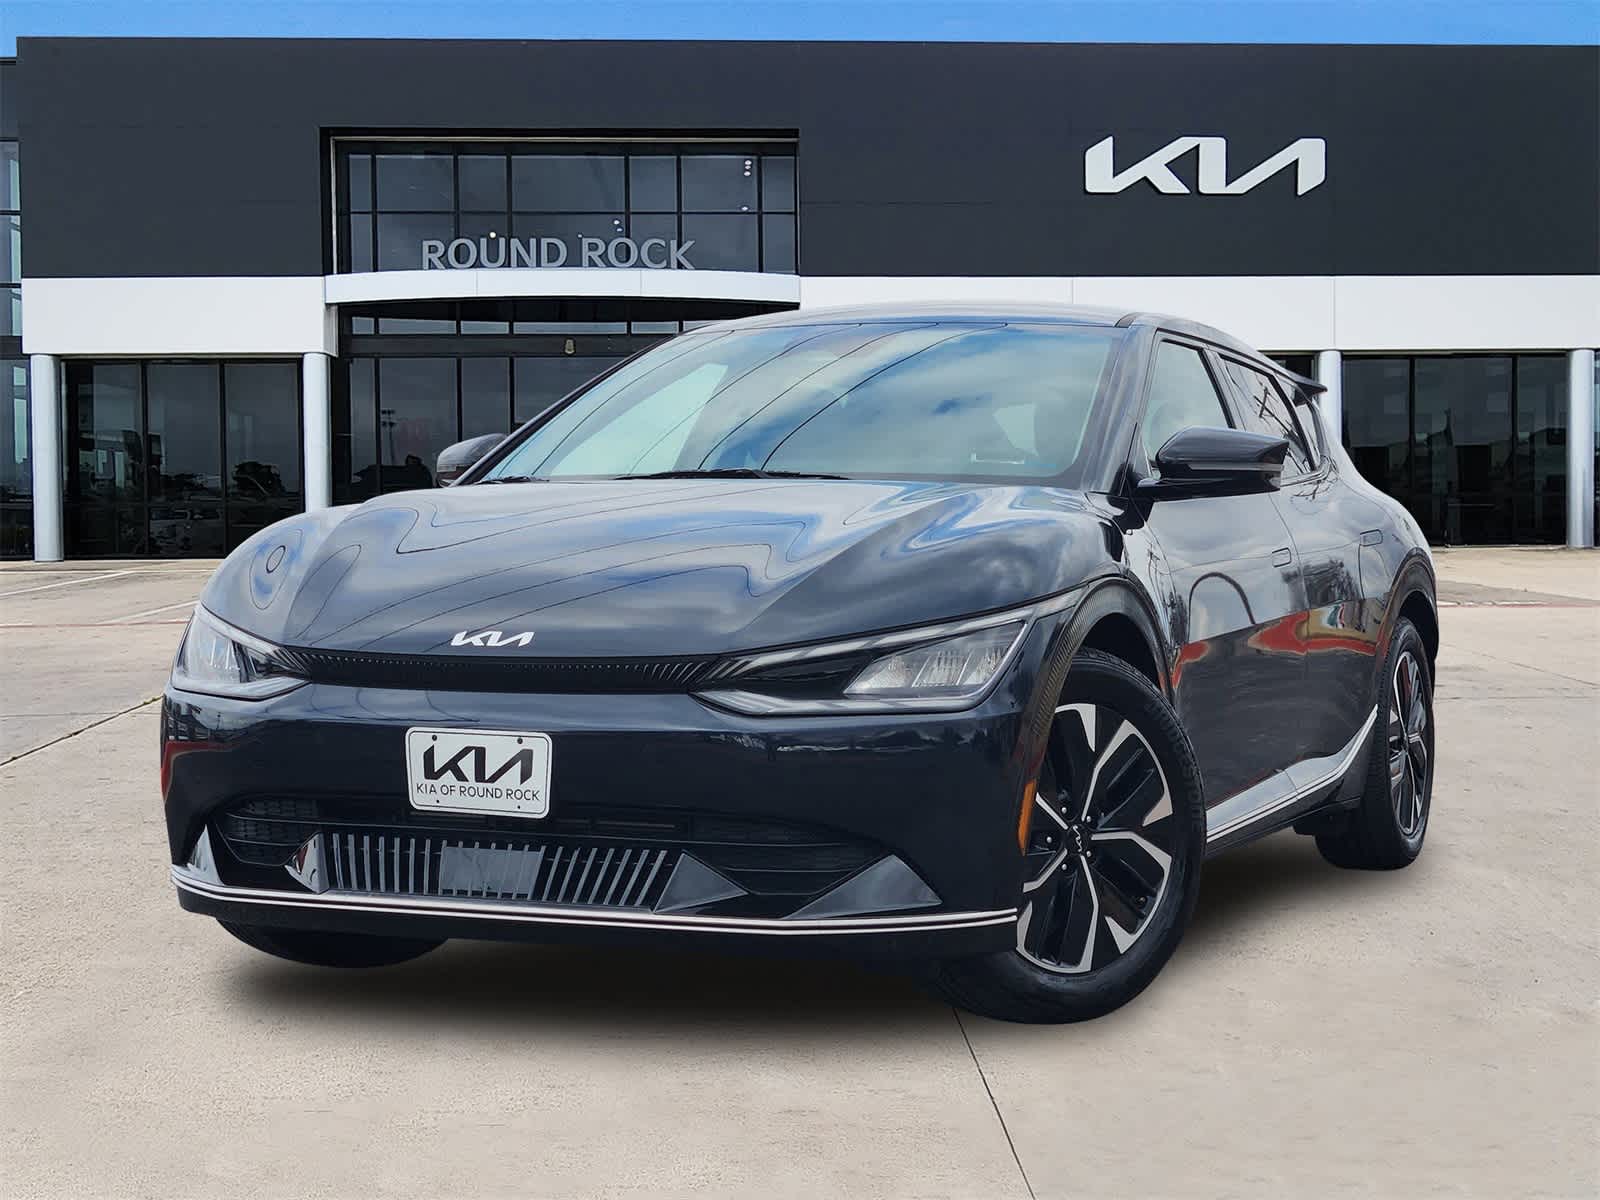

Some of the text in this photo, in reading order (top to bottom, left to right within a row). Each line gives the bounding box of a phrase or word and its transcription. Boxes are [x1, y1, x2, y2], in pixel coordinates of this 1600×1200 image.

[1085, 135, 1326, 196] KIA
[421, 237, 696, 270] ROUND ROCK
[423, 744, 533, 785] KIA
[416, 783, 540, 801] KIA OF ROUND ROCK
